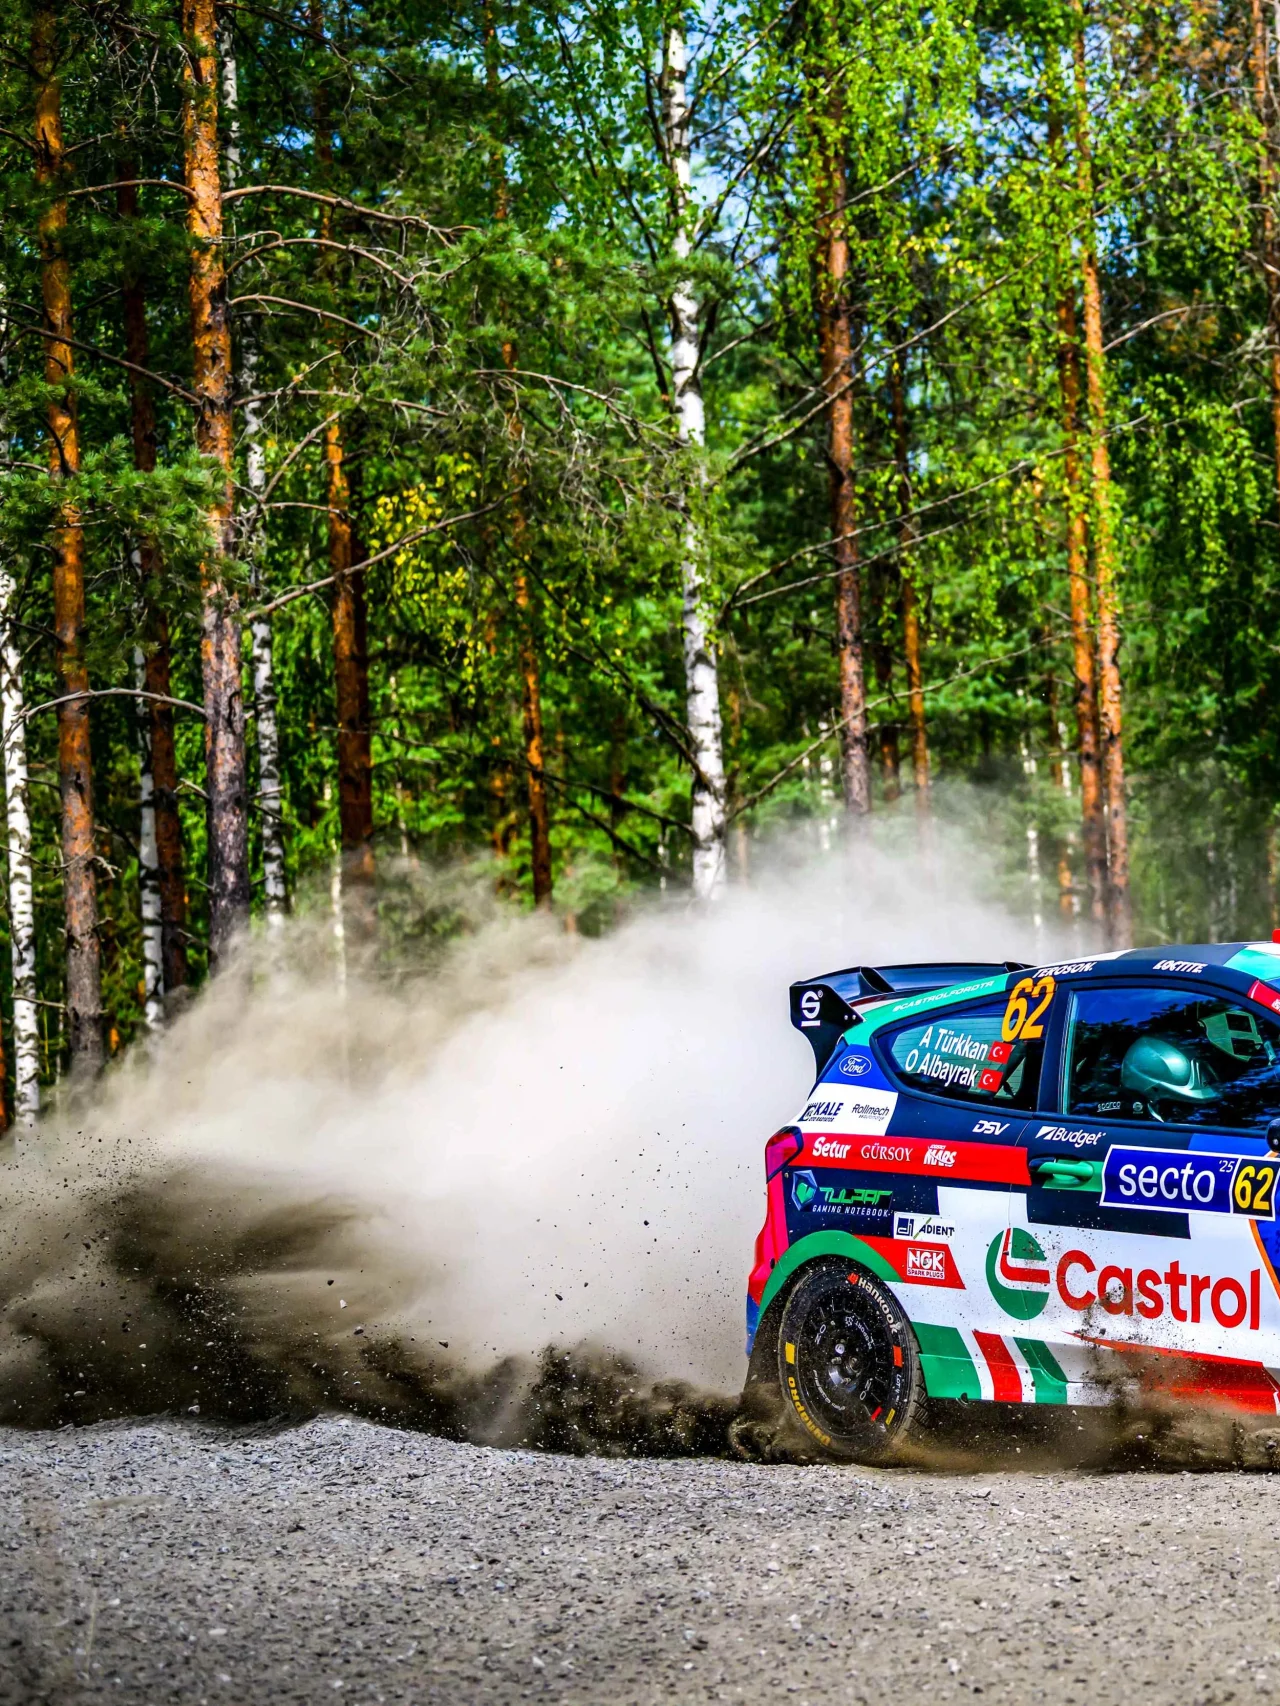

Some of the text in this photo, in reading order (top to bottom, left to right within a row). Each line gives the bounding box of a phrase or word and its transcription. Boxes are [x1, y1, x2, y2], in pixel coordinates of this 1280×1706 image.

[1032, 961, 1097, 979] TEROSON
[1153, 960, 1208, 974] LOCTITE
[1001, 976, 1056, 1043] 62
[919, 1026, 989, 1062] A Türkkan
[842, 1056, 865, 1074] Ford
[905, 1048, 979, 1087] O Albayrak
[813, 1101, 844, 1117] KALE
[852, 1103, 890, 1117] Rollmech
[972, 1119, 1010, 1136] DSV
[1052, 1127, 1104, 1148] Budget
[812, 1136, 851, 1159] Setur
[861, 1142, 914, 1162] GÜRSOY
[1118, 1162, 1275, 1211] secto 62
[812, 1204, 889, 1217] GAMING NOTEBOOK
[918, 1224, 955, 1237] ADIENT
[908, 1250, 944, 1272] NGK
[907, 1268, 945, 1279] SPARK PLUGS
[1056, 1249, 1261, 1331] Castrol
